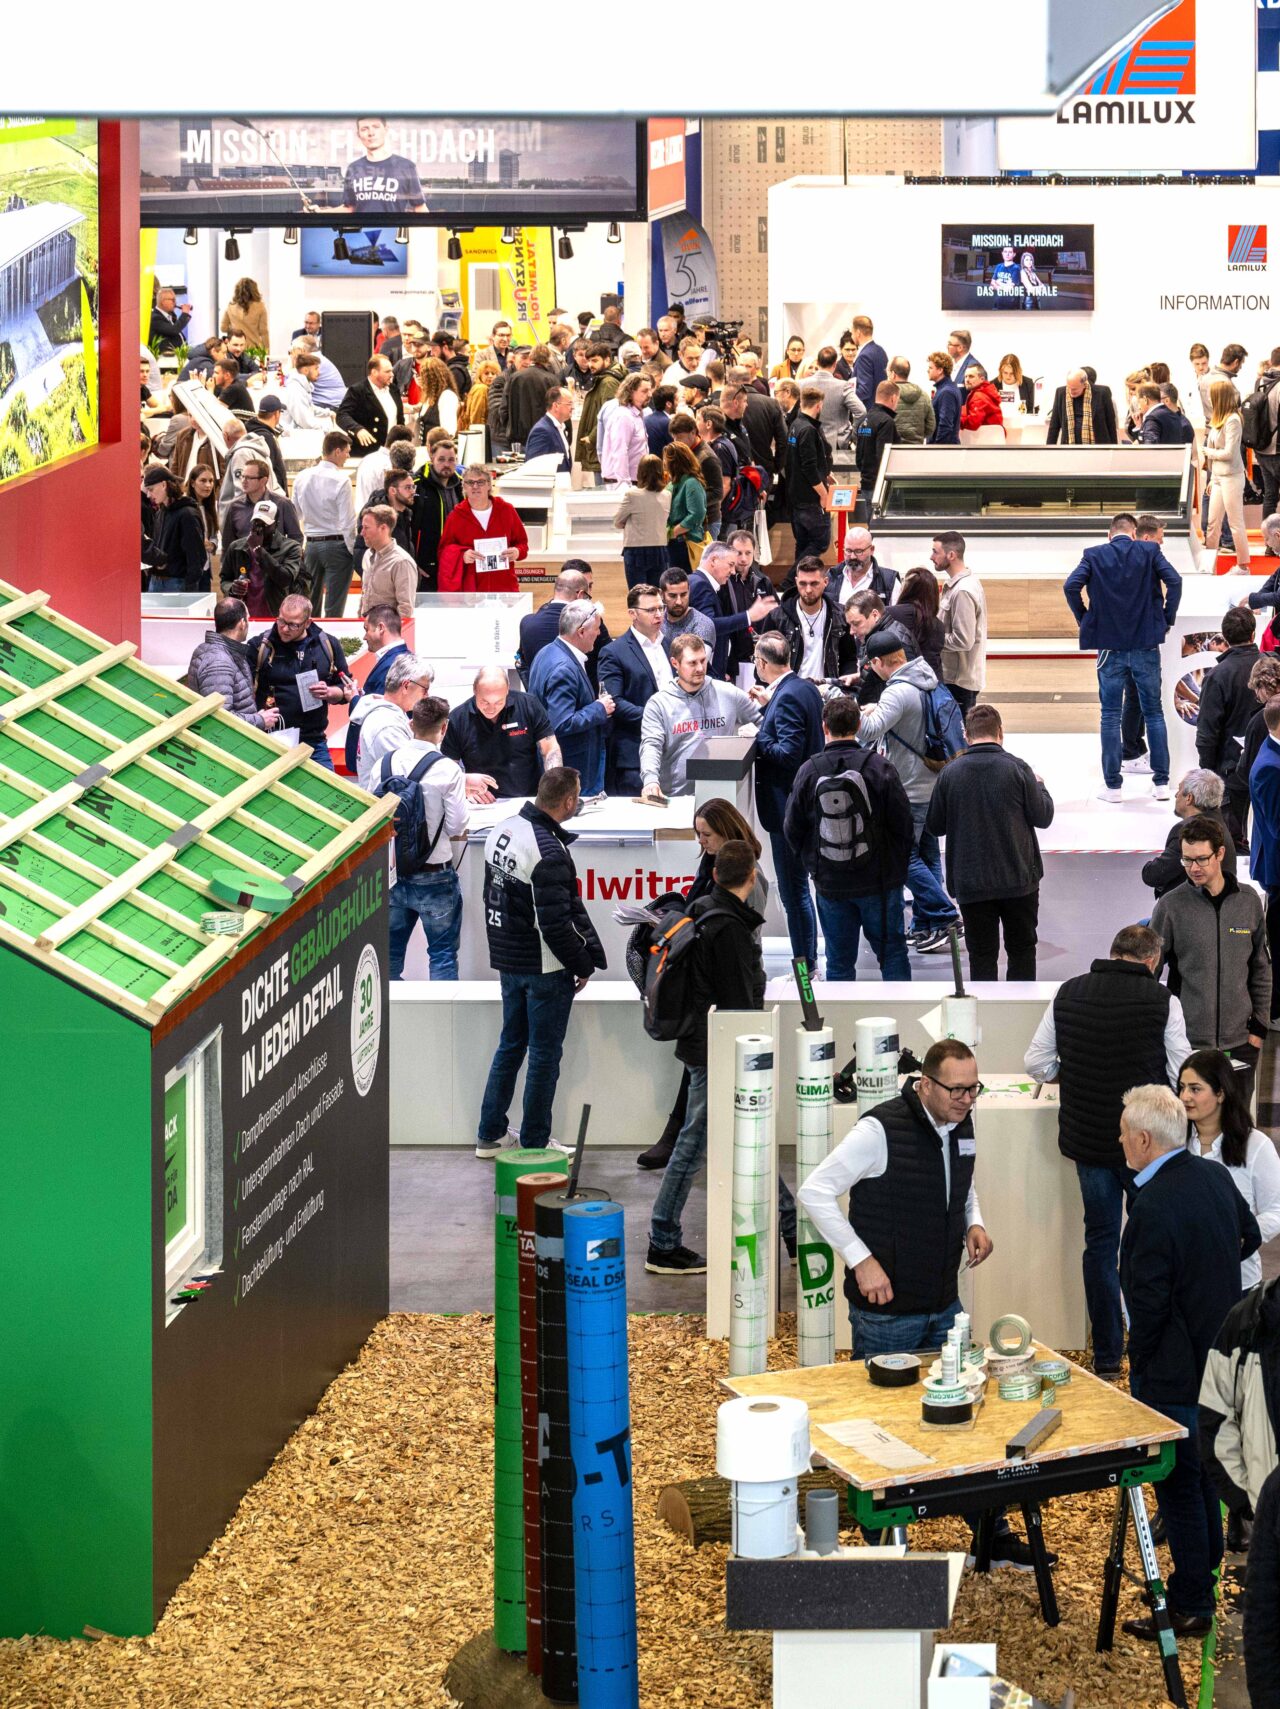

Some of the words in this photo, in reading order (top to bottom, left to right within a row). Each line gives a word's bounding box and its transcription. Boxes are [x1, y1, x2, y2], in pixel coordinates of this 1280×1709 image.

[1057, 101, 1196, 124] LAMILUX
[353, 176, 399, 193] HELD
[972, 234, 1012, 248] MISSION:
[1014, 234, 1064, 248] FLACHDACH
[977, 286, 994, 297] DAS
[1160, 295, 1270, 311] INFORMATION
[672, 719, 699, 735] JACK&
[700, 717, 726, 730] JONES
[488, 909, 502, 927] 25
[241, 951, 289, 1035] DICHTE
[291, 868, 382, 985] GEBÄUDEHÜLLE
[360, 972, 372, 1014] 30
[797, 961, 814, 1003] NEU
[241, 1044, 256, 1098] IN
[258, 1001, 300, 1081] JEDEM
[302, 963, 343, 1037] DETAIL
[358, 1010, 374, 1039] JAHRE
[241, 1100, 284, 1153] Dampfbremsen
[285, 1078, 296, 1107] und
[297, 1051, 328, 1094] Anschlüsse
[241, 1127, 295, 1201] Unterspannbahnen
[295, 1112, 310, 1144] Dach
[311, 1097, 322, 1126] und
[322, 1078, 344, 1114] Fassade
[241, 1184, 287, 1249] Fenstermontage
[288, 1166, 301, 1196] nach
[302, 1152, 315, 1180] RAL
[286, 1216, 297, 1246] und
[297, 1189, 324, 1233] Entlüftung
[566, 1273, 600, 1288] SEAL
